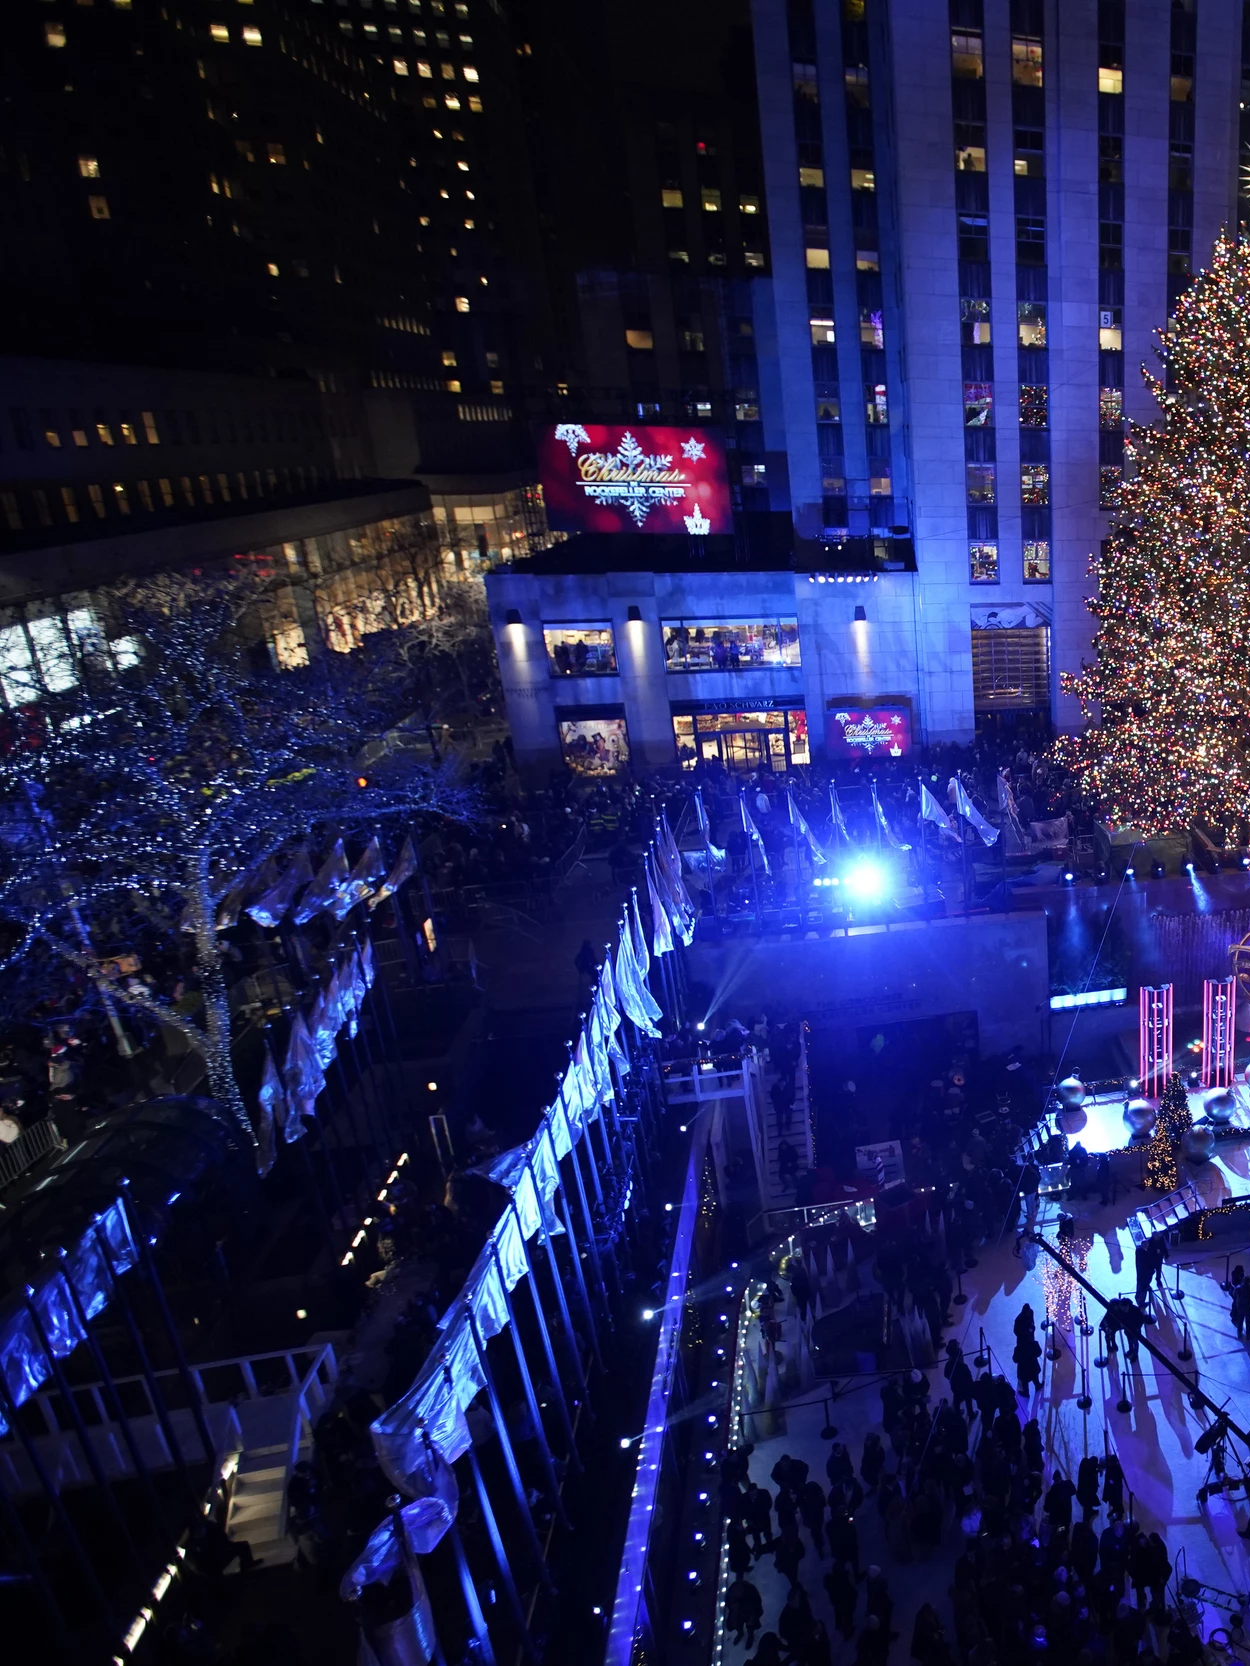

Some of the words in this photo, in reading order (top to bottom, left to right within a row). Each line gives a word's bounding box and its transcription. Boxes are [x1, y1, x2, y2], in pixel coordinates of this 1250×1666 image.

[577, 453, 686, 482] Christmas
[584, 486, 647, 497] ROCKEFELLER
[648, 487, 686, 497] CENTER
[729, 700, 775, 709] SCHWARZ
